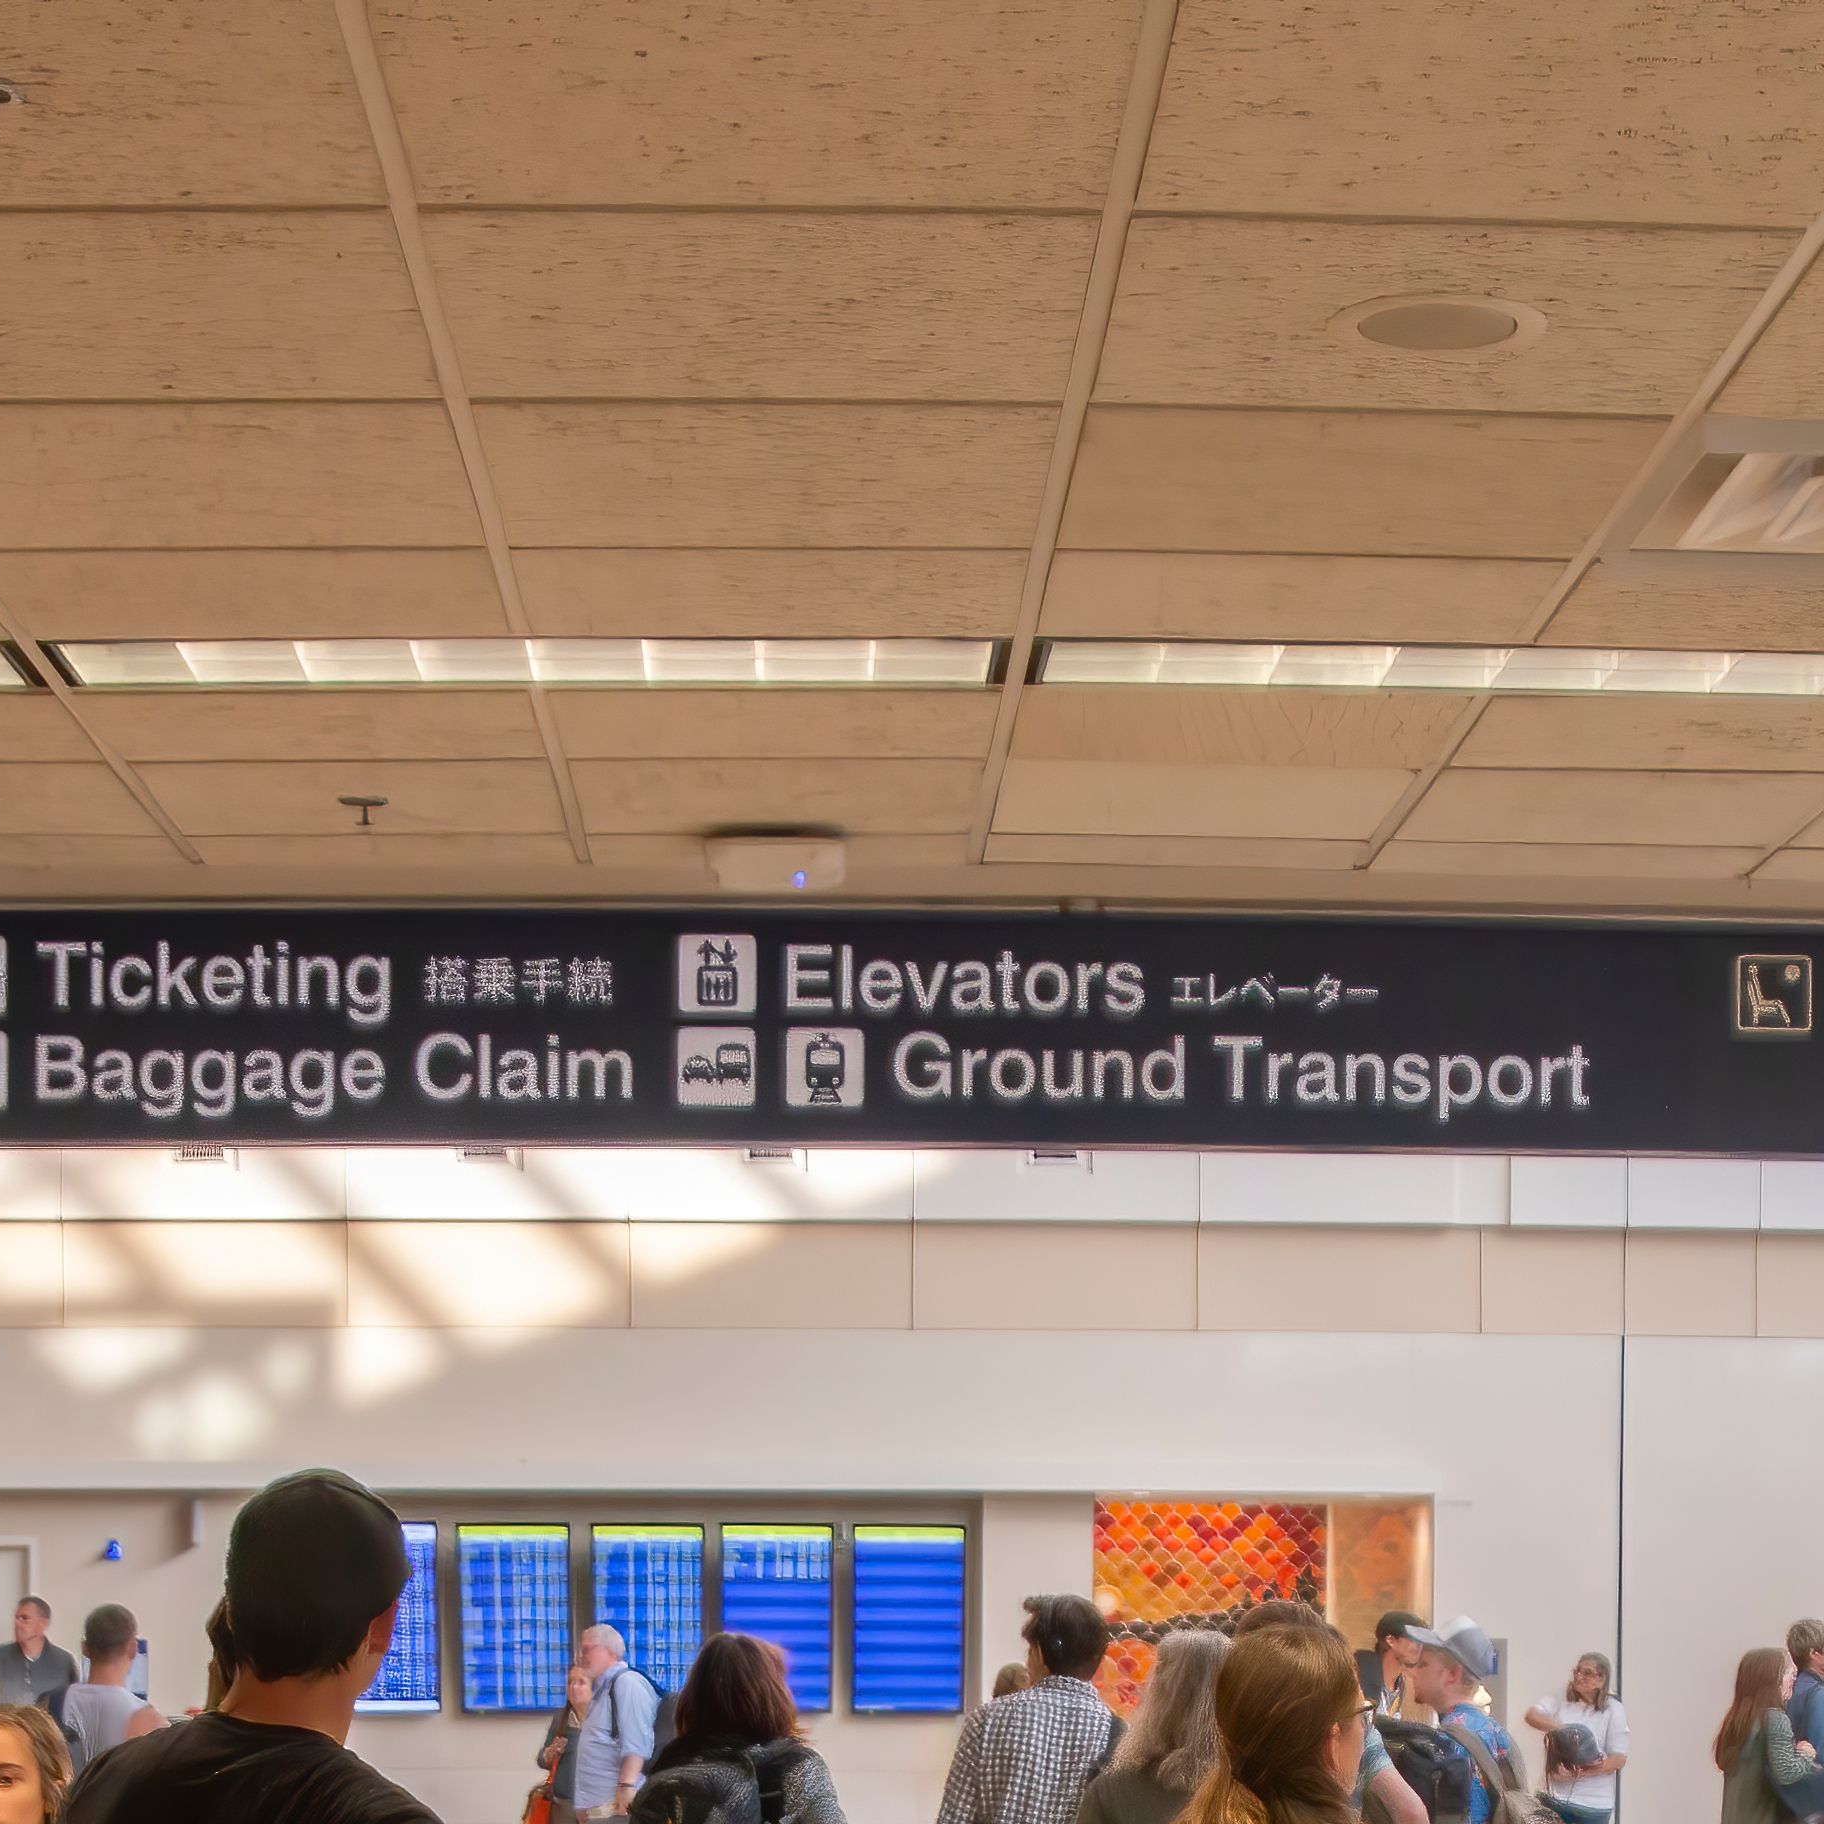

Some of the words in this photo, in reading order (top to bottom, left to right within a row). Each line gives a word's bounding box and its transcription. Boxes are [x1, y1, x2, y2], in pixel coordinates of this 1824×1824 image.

[36, 940, 391, 1025] Ticketing
[785, 943, 1145, 1015] Elevators
[34, 1033, 387, 1120] Baggage
[414, 1032, 634, 1103] Claim
[892, 1030, 1186, 1104] Ground
[1213, 1034, 1591, 1124] Transport
